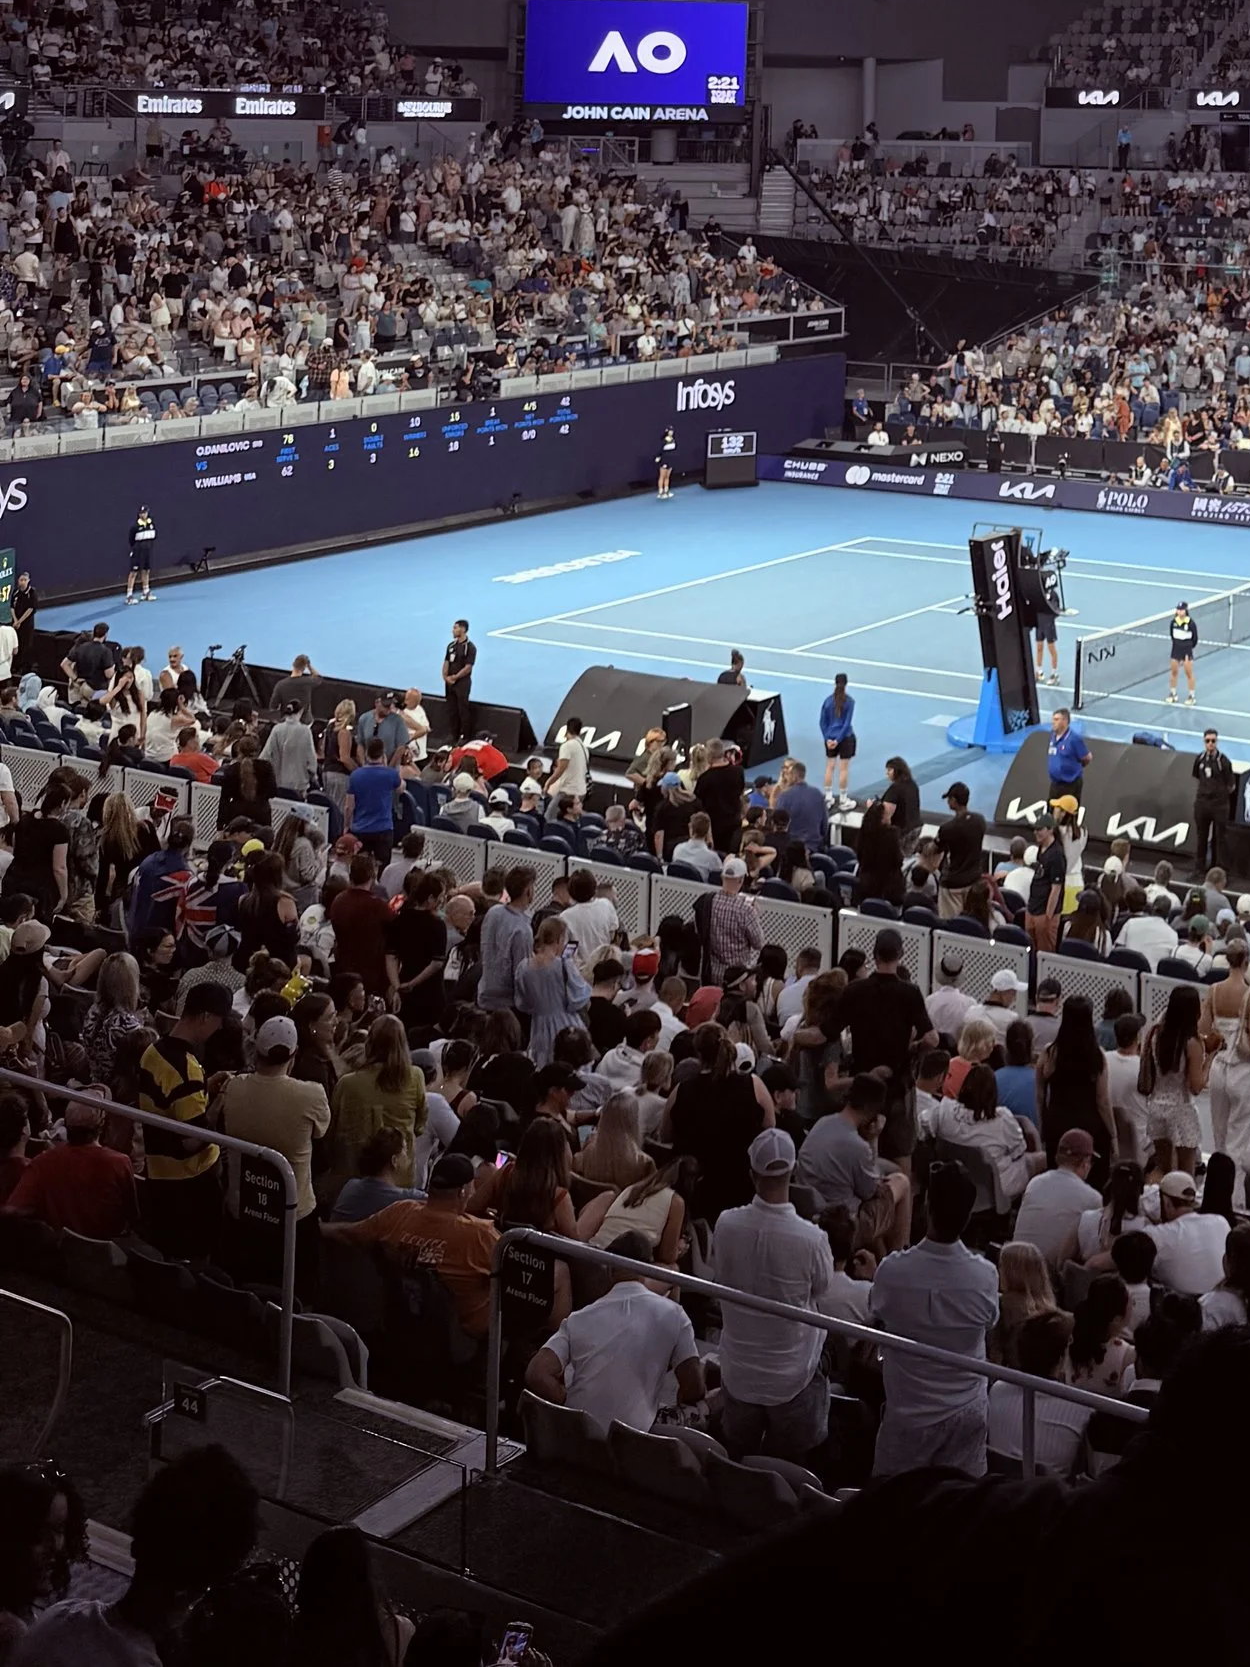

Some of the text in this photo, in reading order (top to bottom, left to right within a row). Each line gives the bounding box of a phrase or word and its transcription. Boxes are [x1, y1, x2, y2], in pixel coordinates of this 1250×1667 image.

[587, 30, 687, 74] AO
[708, 76, 740, 89] 2:21
[137, 95, 202, 113] Emirates
[235, 97, 296, 115] Emirates
[562, 105, 709, 121] JOHN CAIN ARENA
[677, 379, 735, 411] Infosys
[370, 422, 378, 432] 0
[409, 416, 421, 428] 10
[283, 434, 294, 444] 78
[329, 428, 336, 438] 1
[196, 440, 250, 456] O.DANILOVIC
[721, 435, 744, 448] 132
[369, 453, 377, 463] 3
[408, 447, 420, 458] 16
[930, 450, 964, 464] NEXO
[196, 461, 208, 471] VS
[281, 465, 293, 477] 62
[327, 459, 335, 470] 3
[783, 460, 827, 472] CHUBB
[195, 474, 242, 489] V.WILLIAMS
[784, 470, 819, 481] INSURANCE
[871, 472, 925, 485] mastercard
[1107, 491, 1149, 508] POLO
[990, 540, 1012, 621] Haier
[244, 1169, 280, 1191] Section
[257, 1192, 268, 1206] 18
[244, 1206, 280, 1225] Arena Floor
[508, 1245, 545, 1271] Section
[521, 1270, 533, 1285] 17
[505, 1285, 548, 1307] Arena Floor
[181, 1397, 199, 1415] 44
